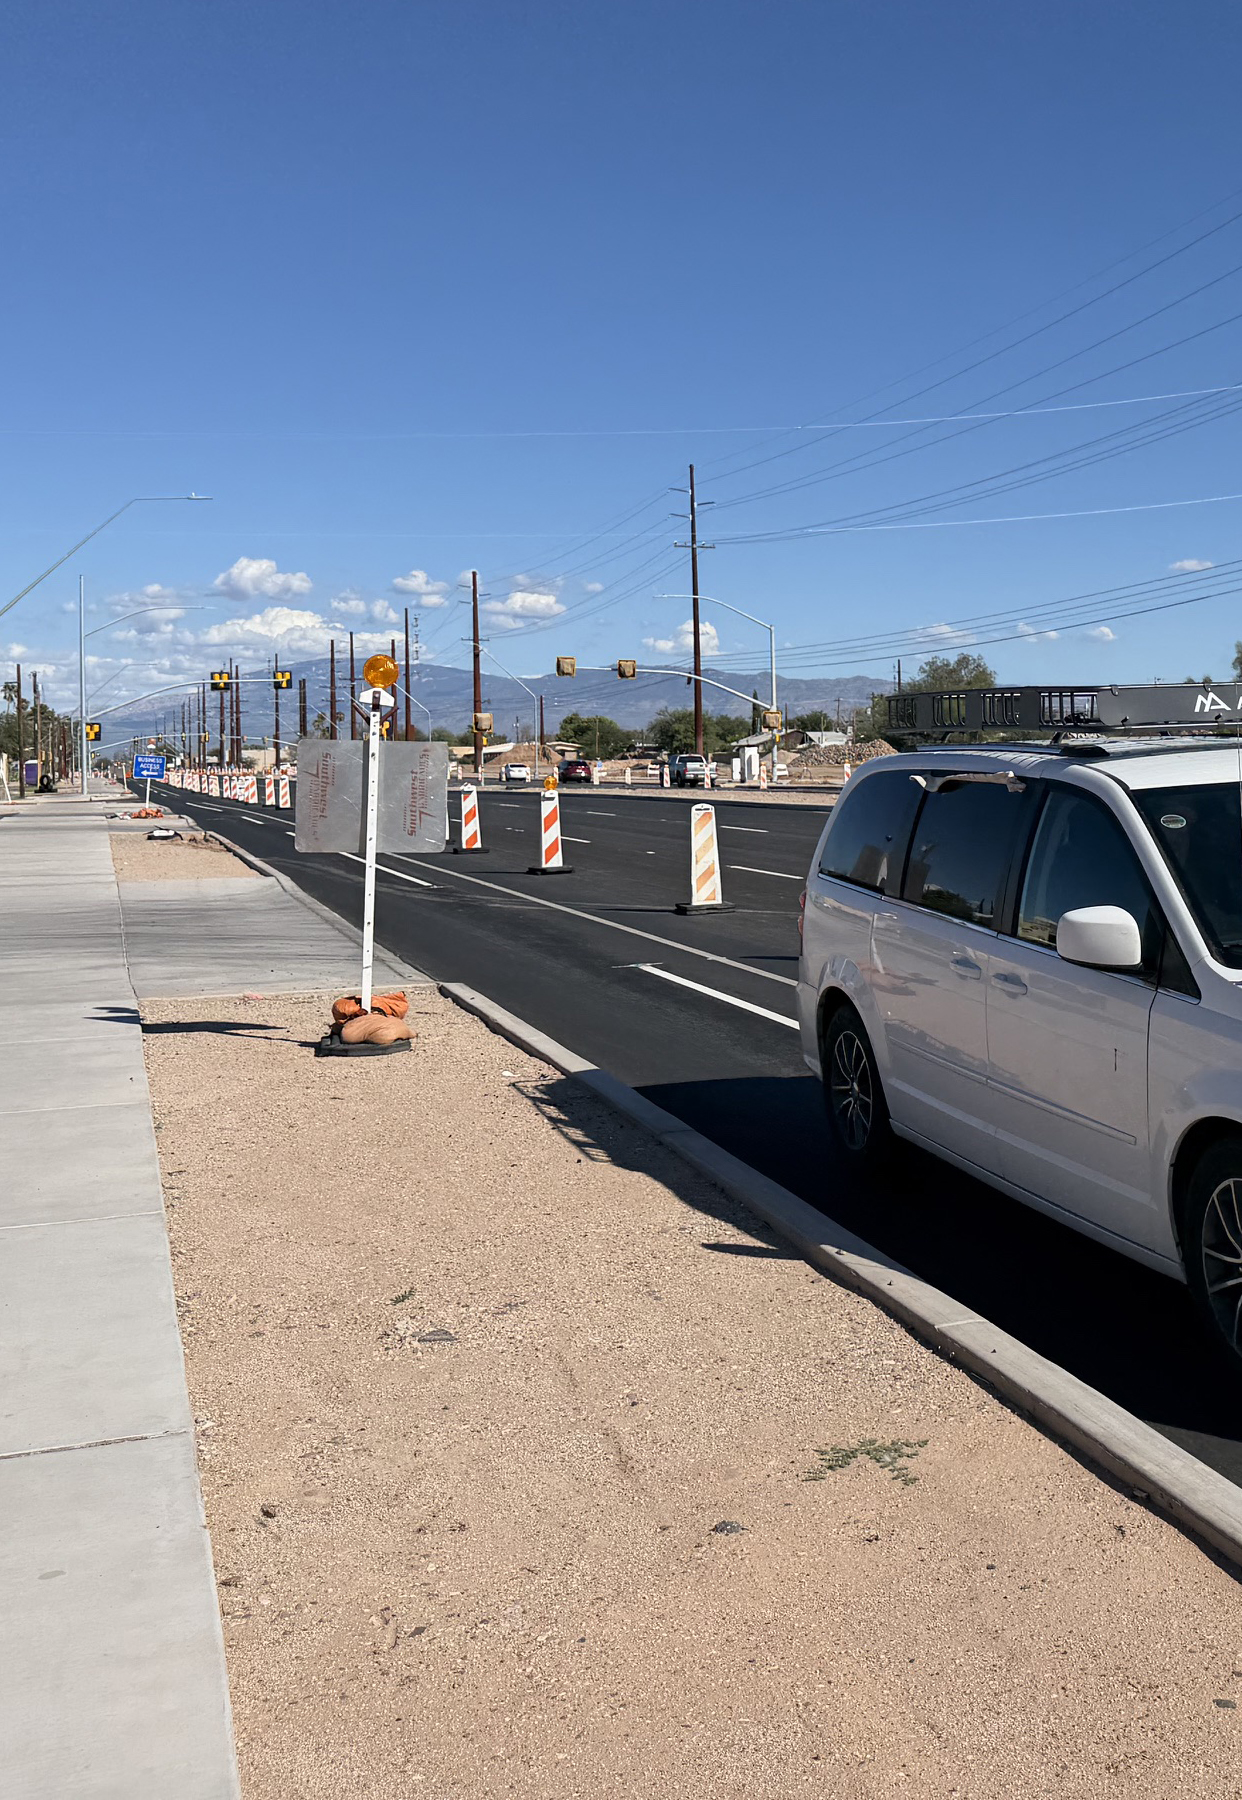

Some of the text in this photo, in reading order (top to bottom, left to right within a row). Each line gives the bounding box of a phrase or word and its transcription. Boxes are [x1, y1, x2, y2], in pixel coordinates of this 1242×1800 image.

[137, 756, 163, 764] BUSINESS
[139, 762, 160, 770] ACCESS
[319, 752, 333, 819] Southwest
[407, 769, 418, 837] Southwest
